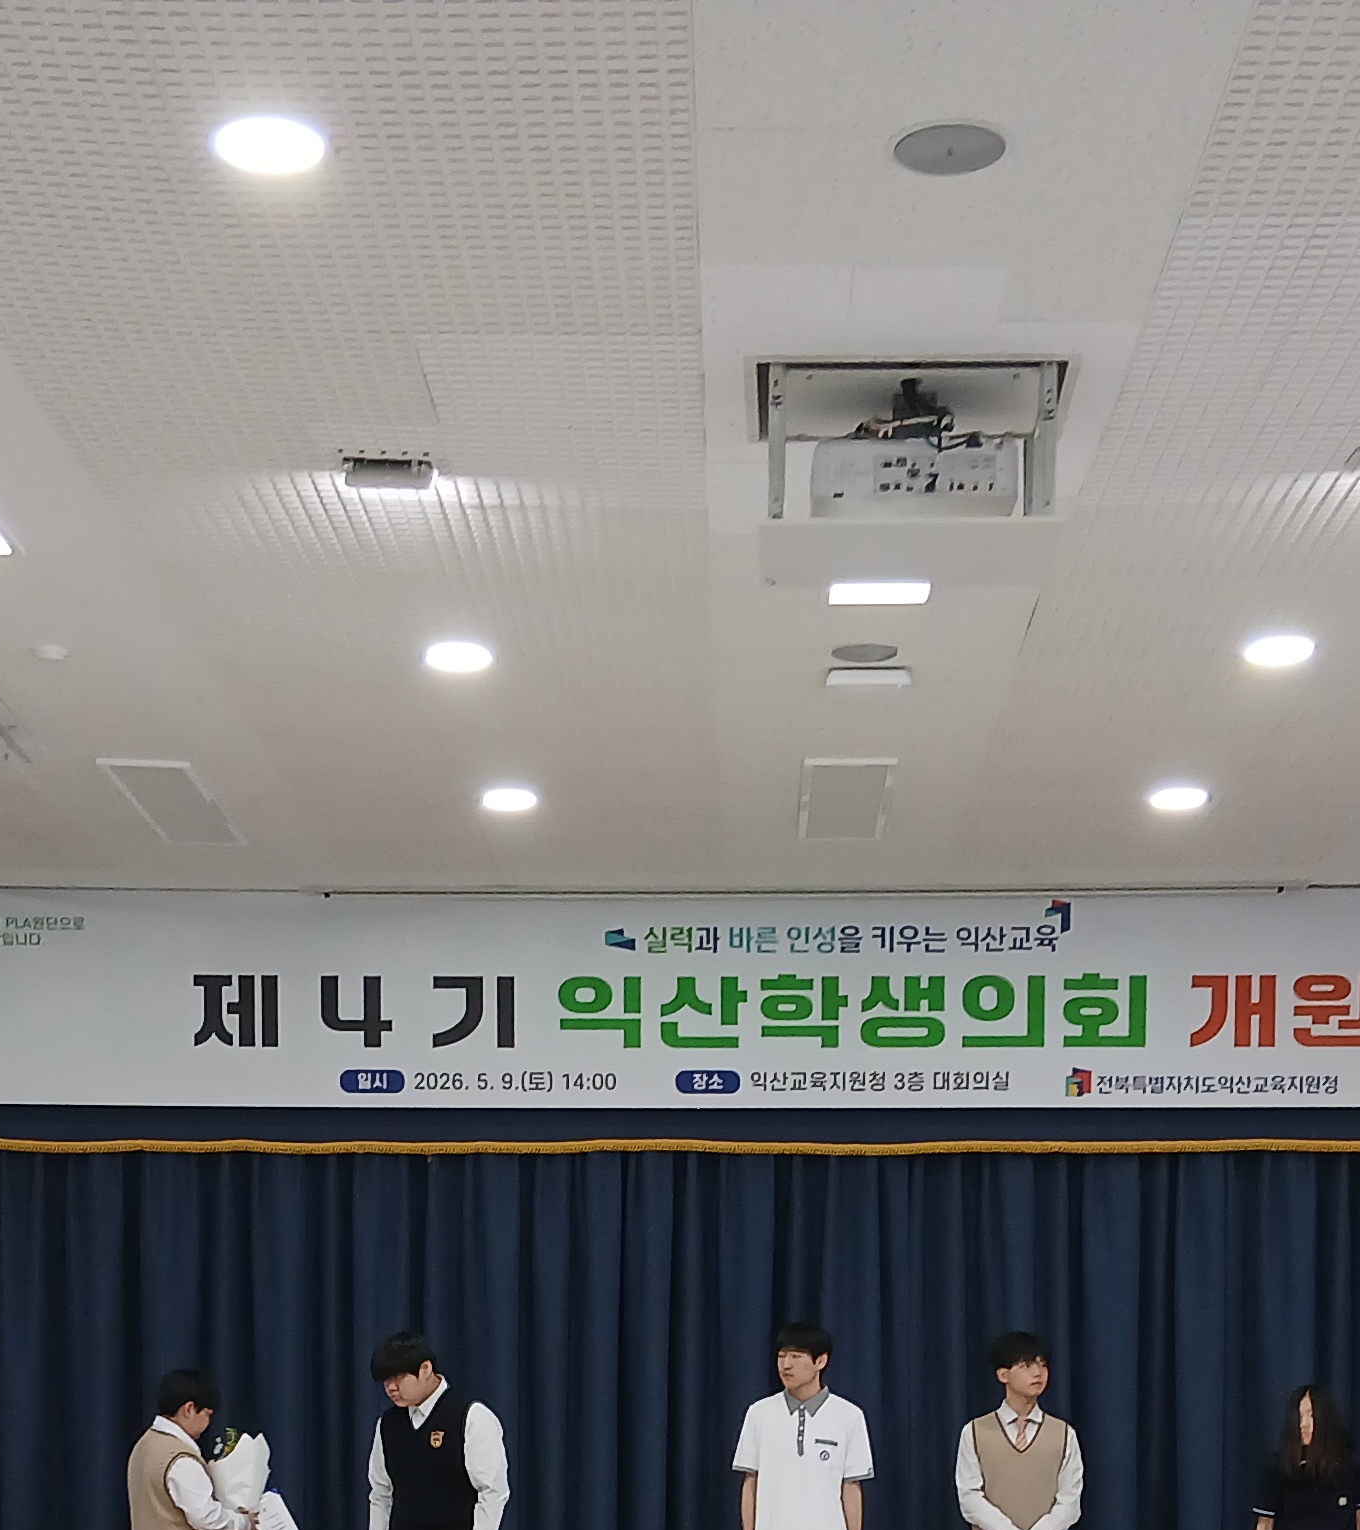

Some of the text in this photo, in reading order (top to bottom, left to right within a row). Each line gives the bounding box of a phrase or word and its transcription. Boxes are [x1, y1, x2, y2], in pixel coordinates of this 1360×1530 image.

[644, 924, 1060, 954] 실력과 바른 인성을 키우는 익산교육
[193, 974, 279, 1048] 제
[320, 974, 393, 1049] 4
[432, 974, 515, 1049] 기
[557, 973, 1148, 1050] 익산학생의회
[357, 1072, 389, 1090] 일시
[413, 1072, 470, 1091] 2026.
[476, 1073, 494, 1091] 5.
[561, 1073, 618, 1091] 14:00
[691, 1070, 1011, 1092] 장소 익산교육지원청 3층 대회의실
[1096, 1075, 1340, 1095] 전북특별자치도익산교육지원청
